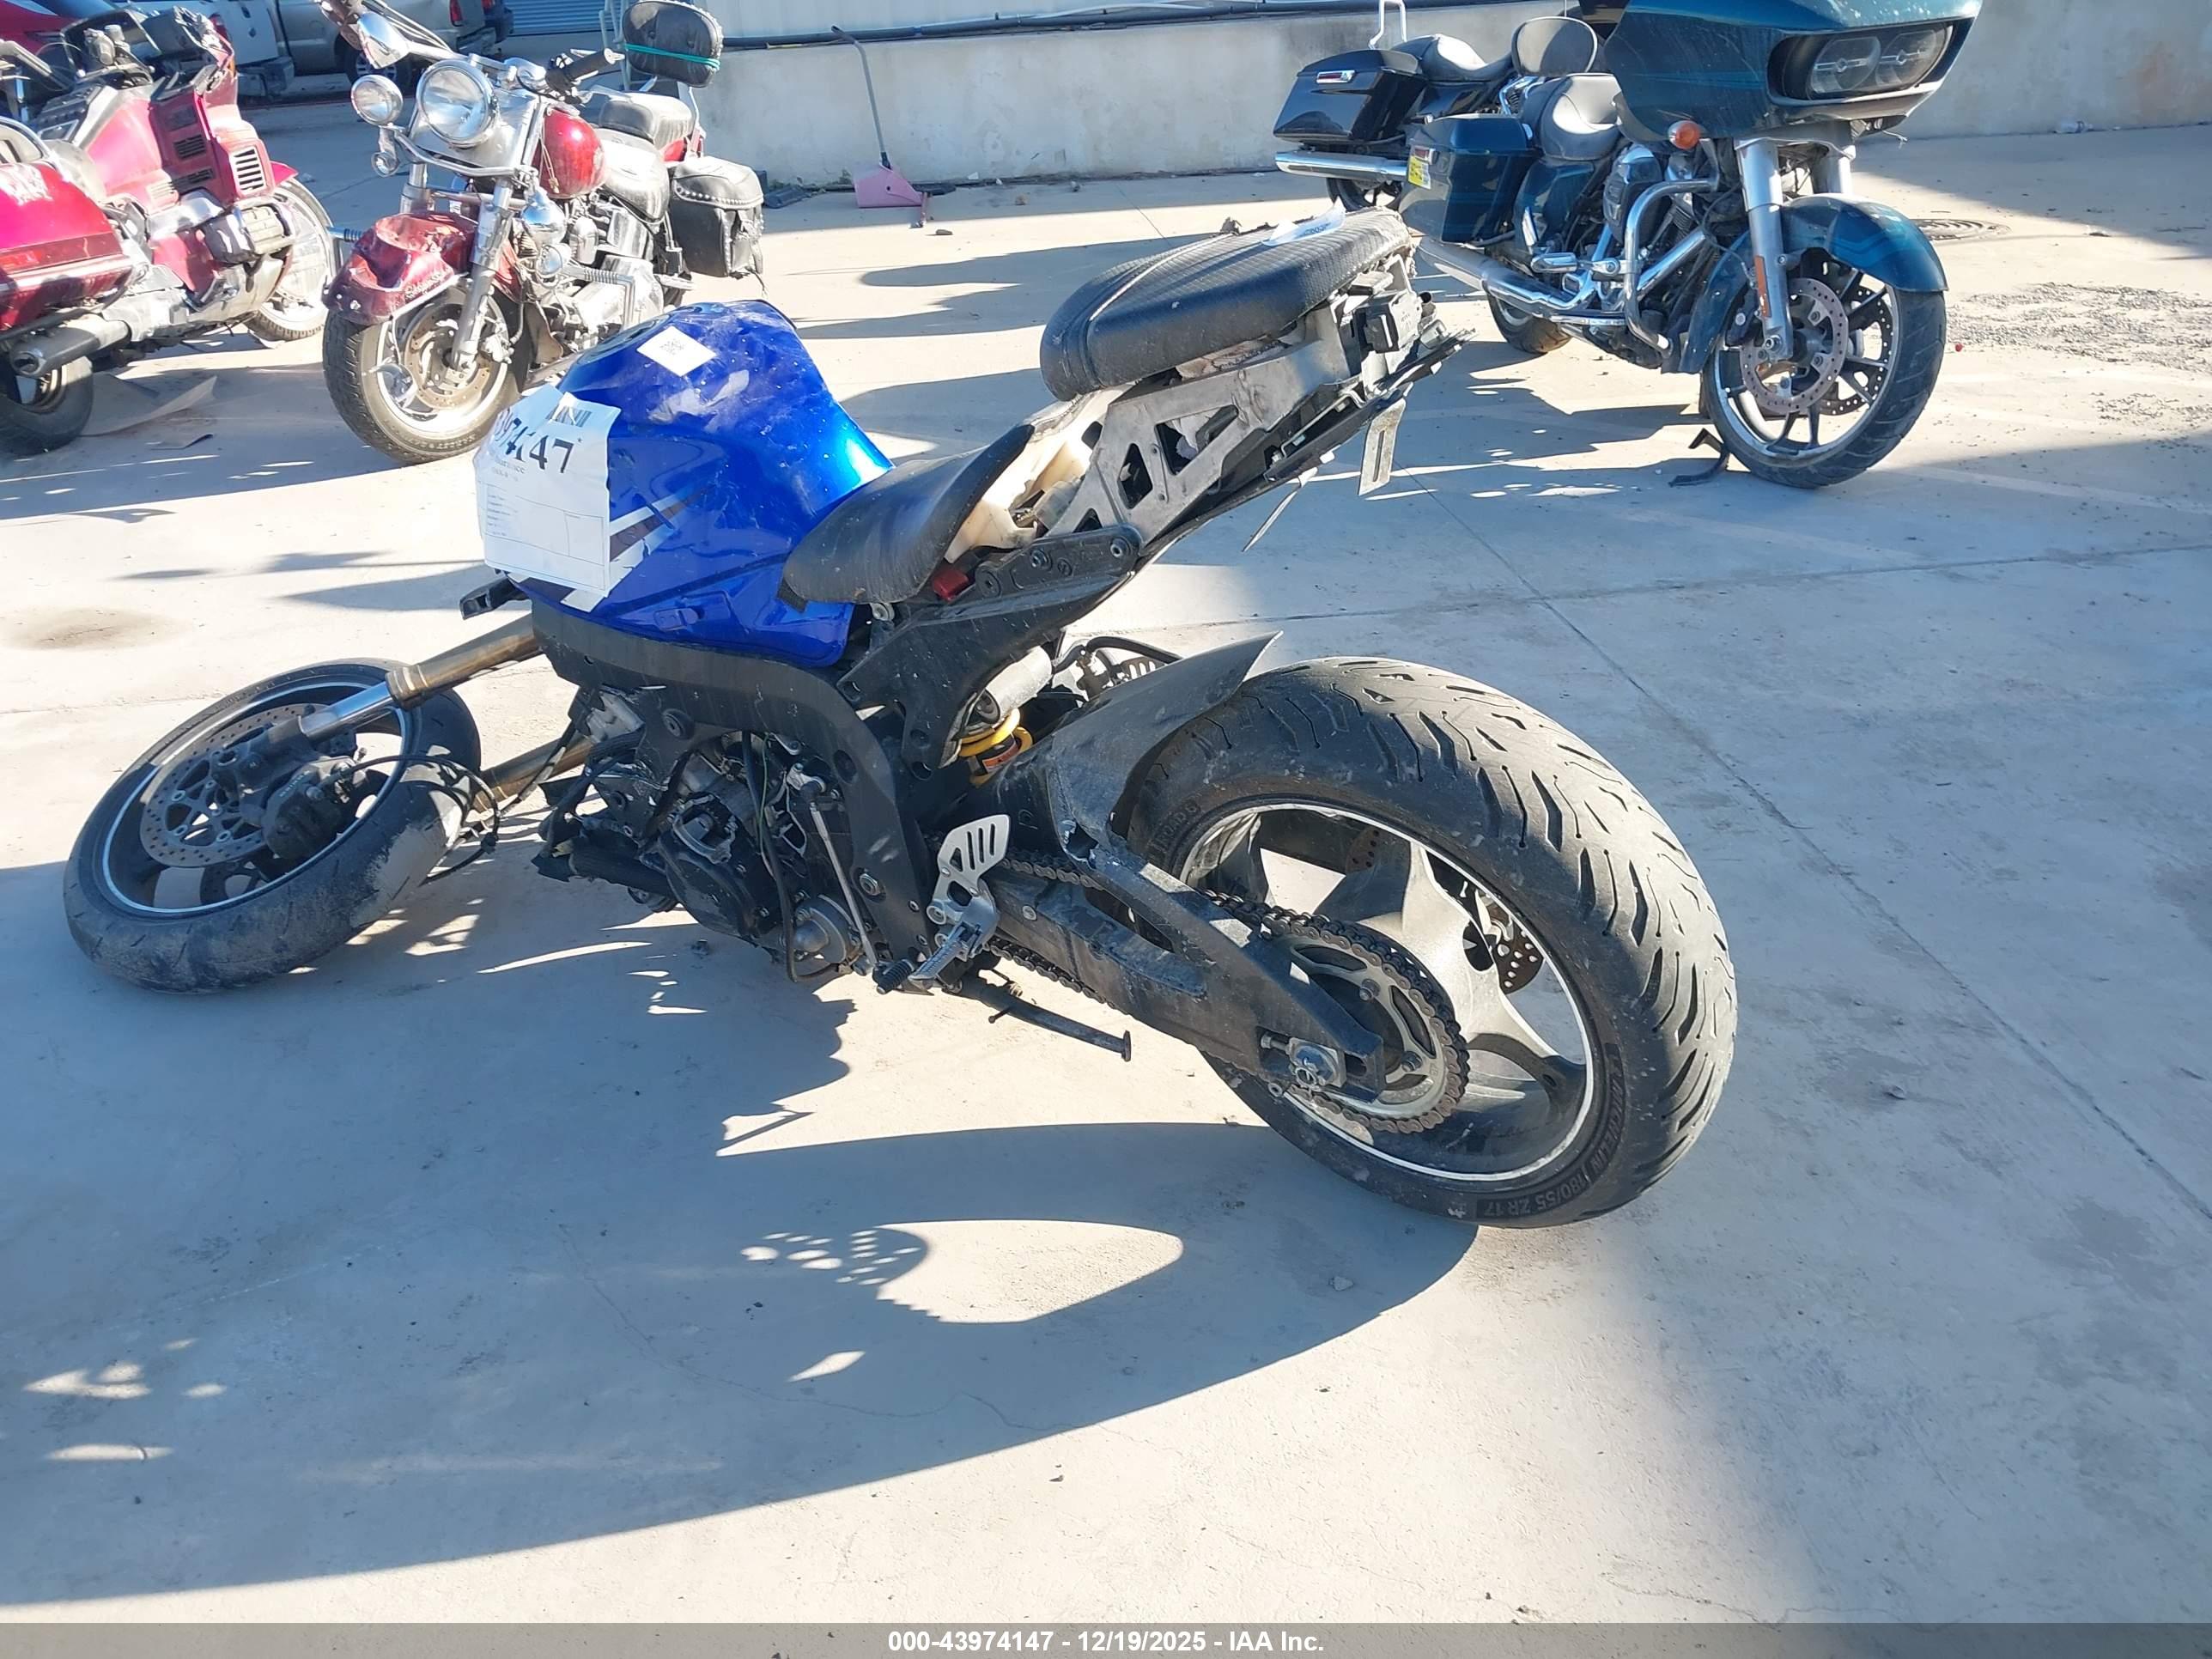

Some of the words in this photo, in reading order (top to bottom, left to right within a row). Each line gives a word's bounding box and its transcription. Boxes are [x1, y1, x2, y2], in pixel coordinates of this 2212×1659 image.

[1595, 1077, 1625, 1172] MICHELIN
[1535, 1174, 1586, 1212] 180/55
[1483, 1201, 1503, 1216] 17
[1508, 1199, 1531, 1216] ZR
